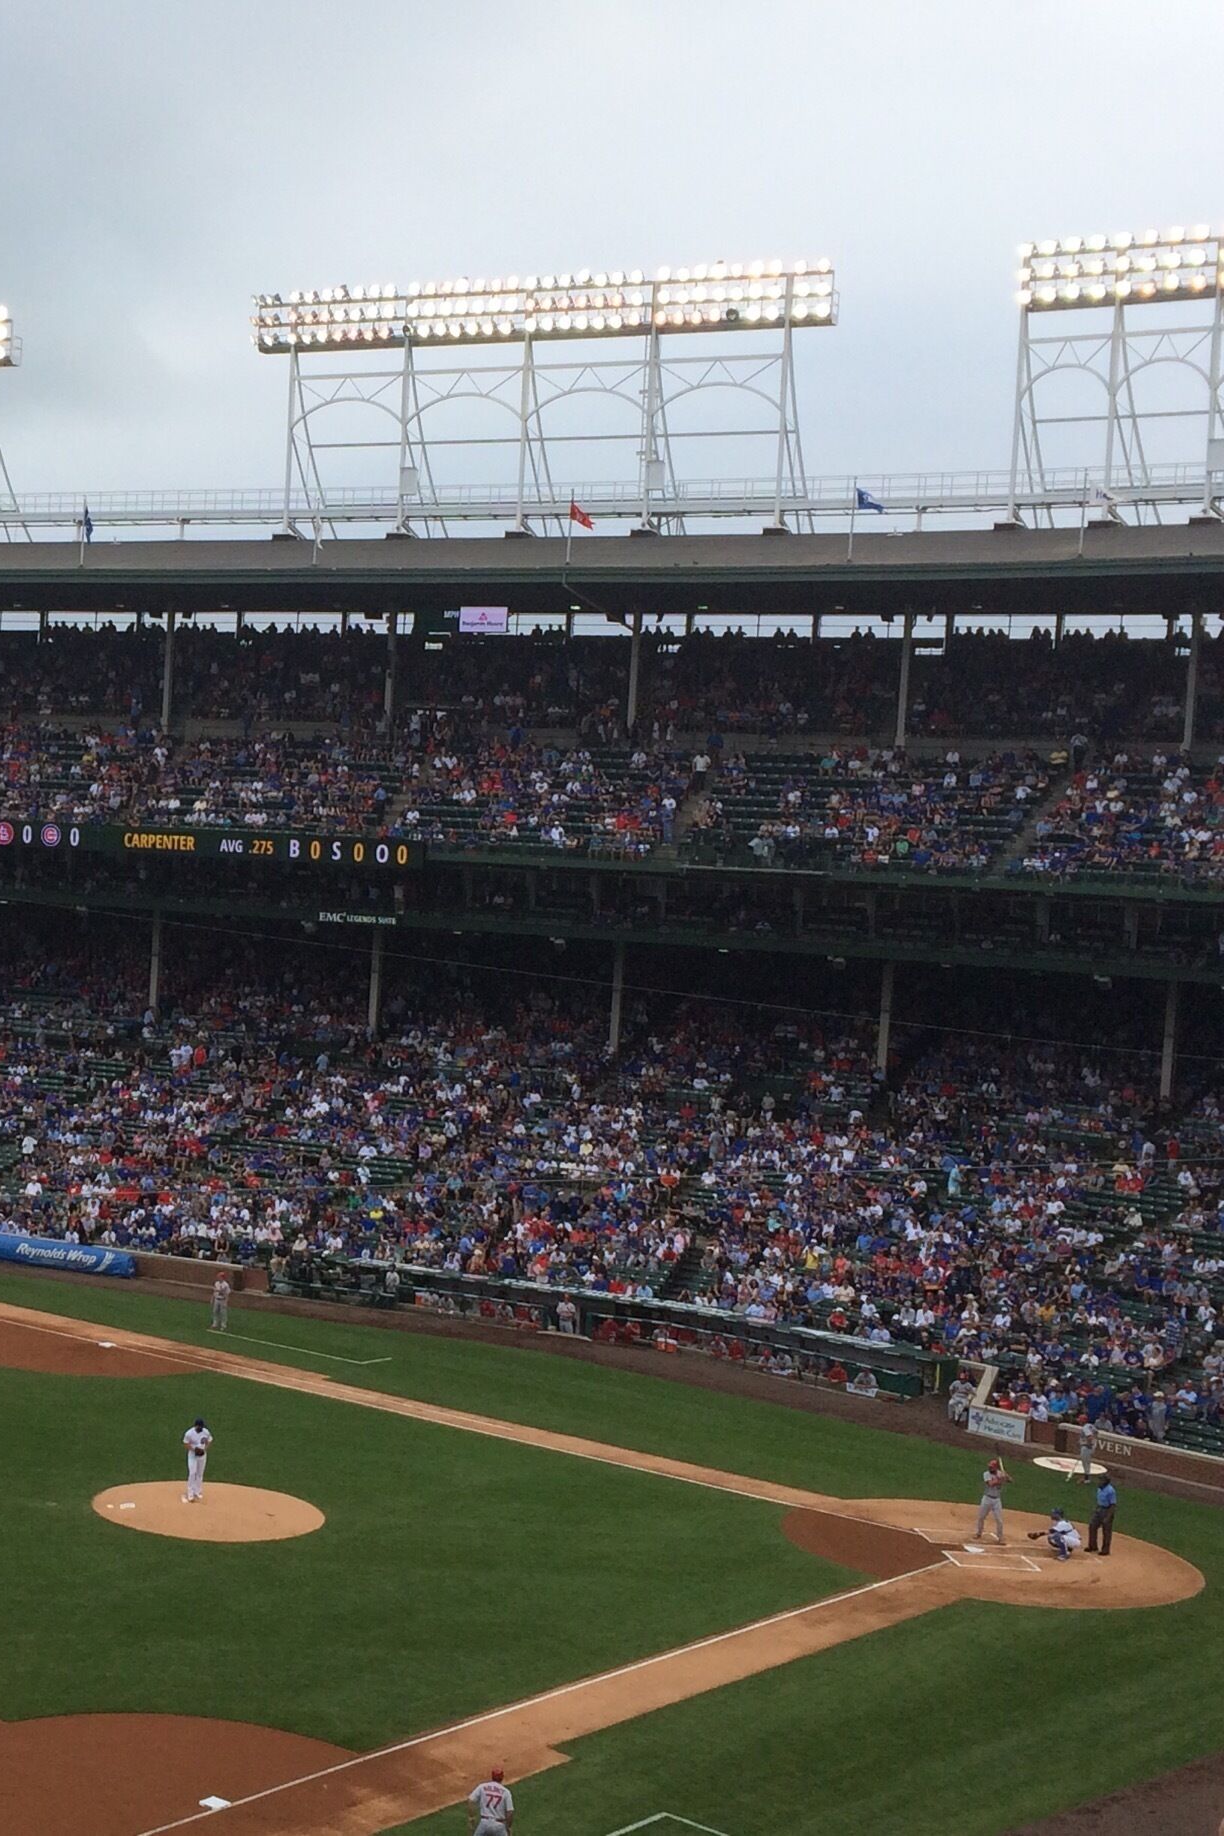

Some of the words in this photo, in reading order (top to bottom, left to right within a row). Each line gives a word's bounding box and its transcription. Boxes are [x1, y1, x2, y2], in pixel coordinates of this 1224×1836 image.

[22, 824, 33, 844] 0
[69, 827, 80, 847] 0
[124, 832, 195, 851] CARPENTER
[219, 838, 244, 853] AVG
[248, 840, 274, 855] .275
[289, 839, 300, 858] B
[310, 840, 321, 860] 0
[331, 841, 342, 861] S
[353, 842, 364, 862] 0
[396, 845, 408, 865] 0
[16, 1242, 67, 1261] Reynolds
[66, 1248, 97, 1266] Wrap
[485, 1793, 503, 1809] 77
